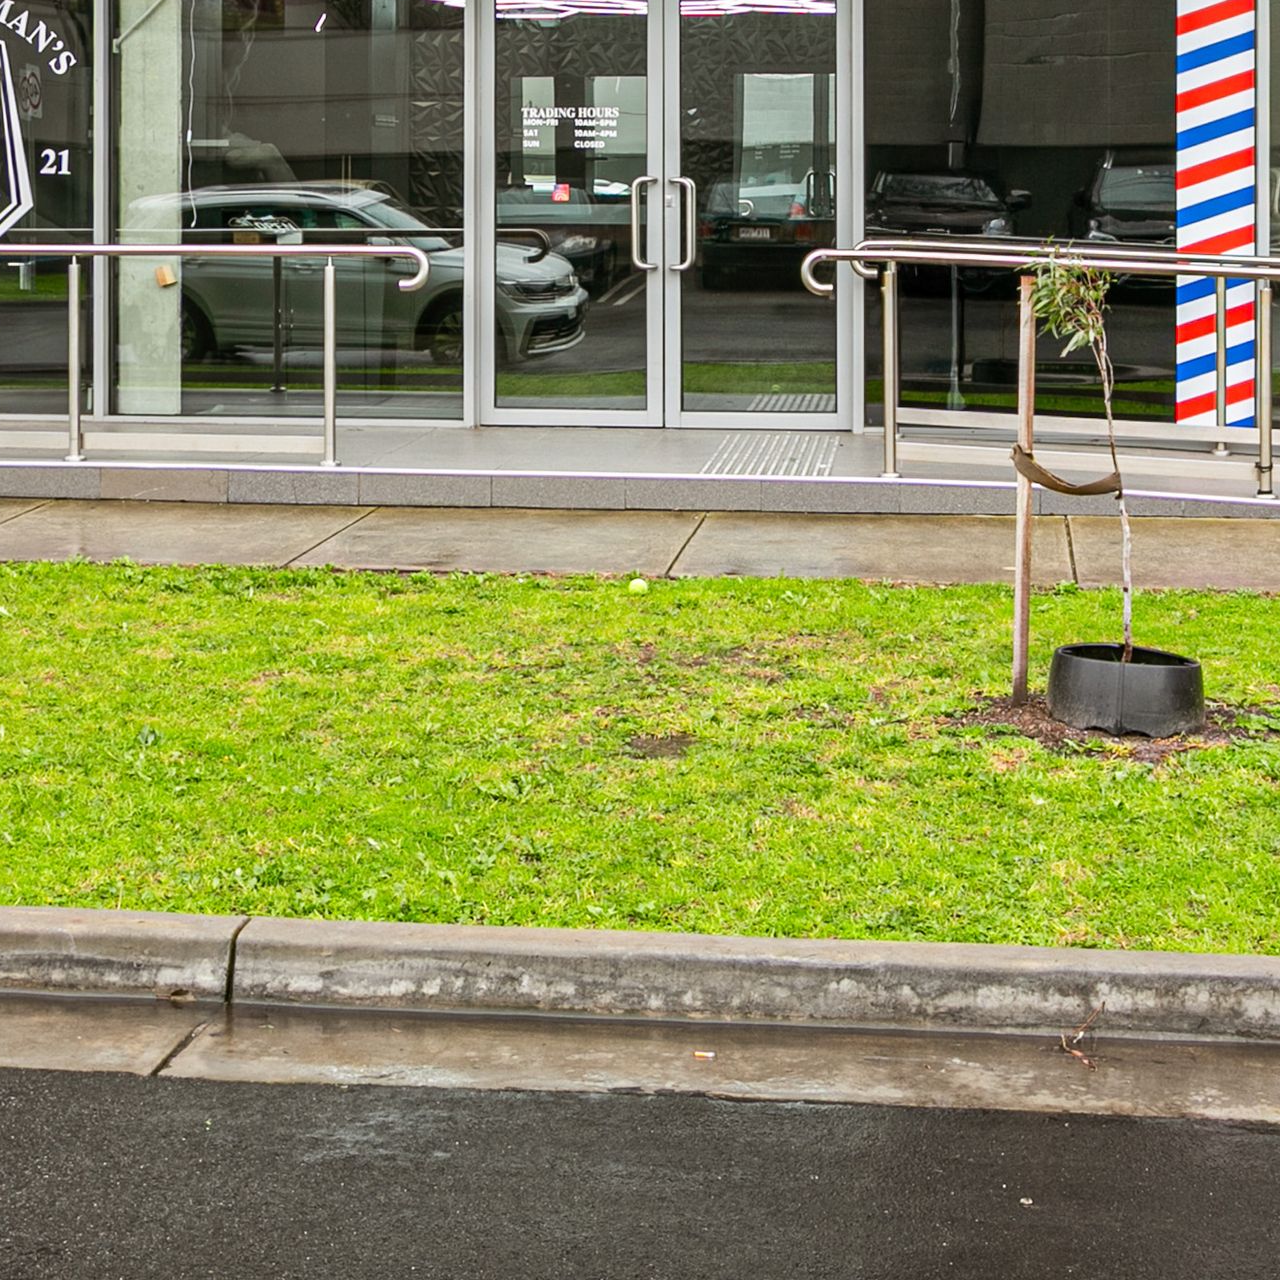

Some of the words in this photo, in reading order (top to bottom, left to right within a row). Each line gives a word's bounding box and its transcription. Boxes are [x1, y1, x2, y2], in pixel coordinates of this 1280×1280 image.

[520, 107, 576, 119] TRADING
[578, 107, 620, 119] HOURS
[522, 129, 539, 137] SAT
[522, 140, 540, 148] SUN
[574, 140, 606, 149] CLOSED
[39, 147, 72, 176] 21
